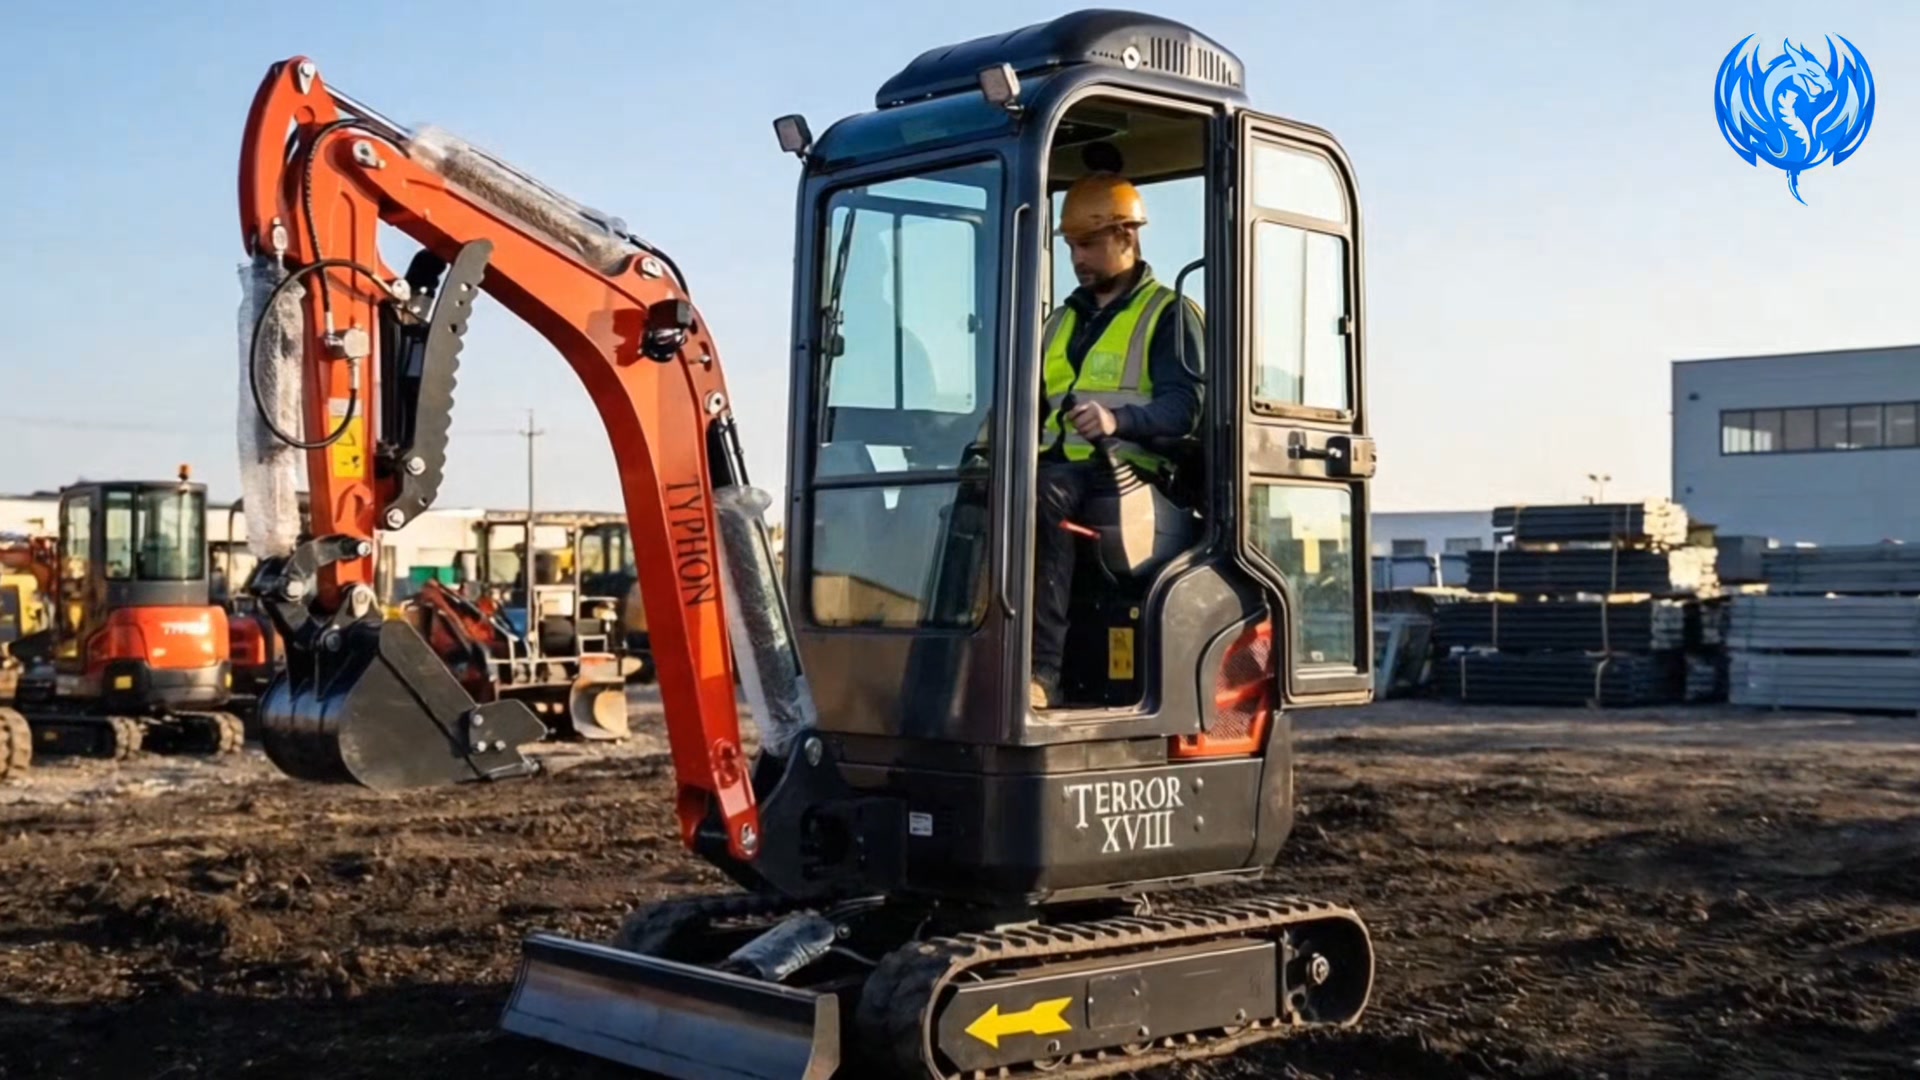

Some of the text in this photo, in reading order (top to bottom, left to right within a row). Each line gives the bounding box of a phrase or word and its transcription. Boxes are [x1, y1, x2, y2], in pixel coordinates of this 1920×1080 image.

[665, 475, 716, 606] TYPHON
[1064, 776, 1184, 829] TERROR
[1101, 810, 1175, 853] XVIII
